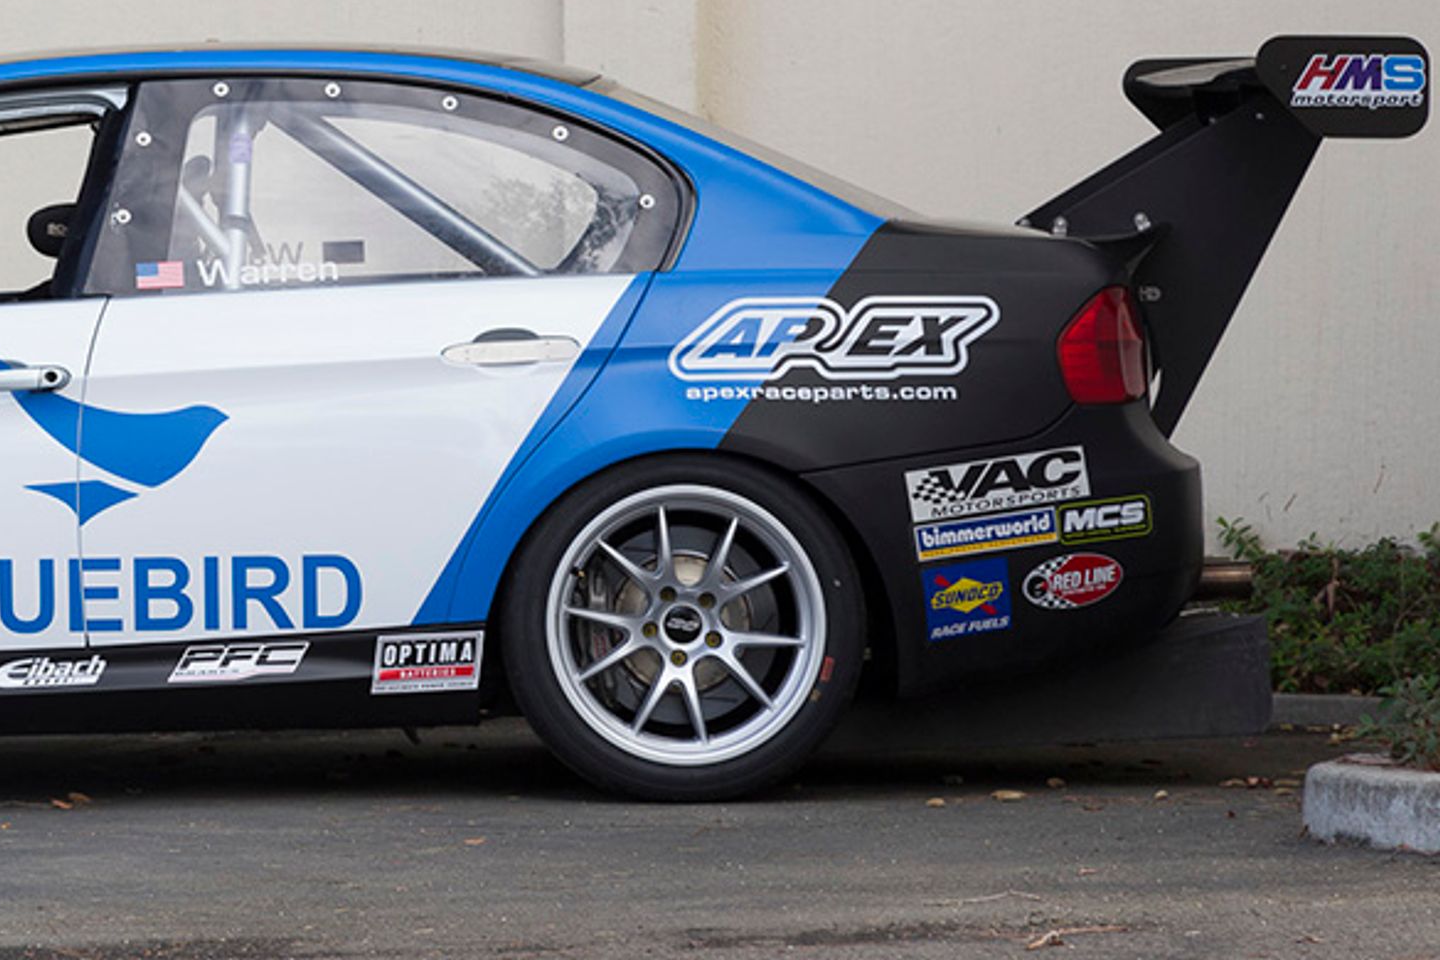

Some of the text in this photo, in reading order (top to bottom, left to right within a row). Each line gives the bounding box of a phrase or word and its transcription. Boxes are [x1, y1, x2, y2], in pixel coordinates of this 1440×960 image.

[1293, 54, 1425, 92] HMS
[1291, 93, 1424, 110] motorsport
[197, 256, 340, 287] Warren
[682, 308, 987, 368] APEX
[686, 384, 957, 402] apexraceparts.com
[928, 450, 1082, 499] VAC
[931, 485, 1081, 517] MOTORSPORTS
[921, 512, 1051, 548] bimmerworld
[1063, 501, 1145, 533] MCS
[1053, 571, 1082, 591] RED
[1084, 564, 1116, 585] LINE
[934, 582, 1003, 609] SUNOCO
[931, 616, 1010, 640] RACE FUELS
[179, 644, 308, 669] PFC
[383, 641, 472, 666] OPTIMA
